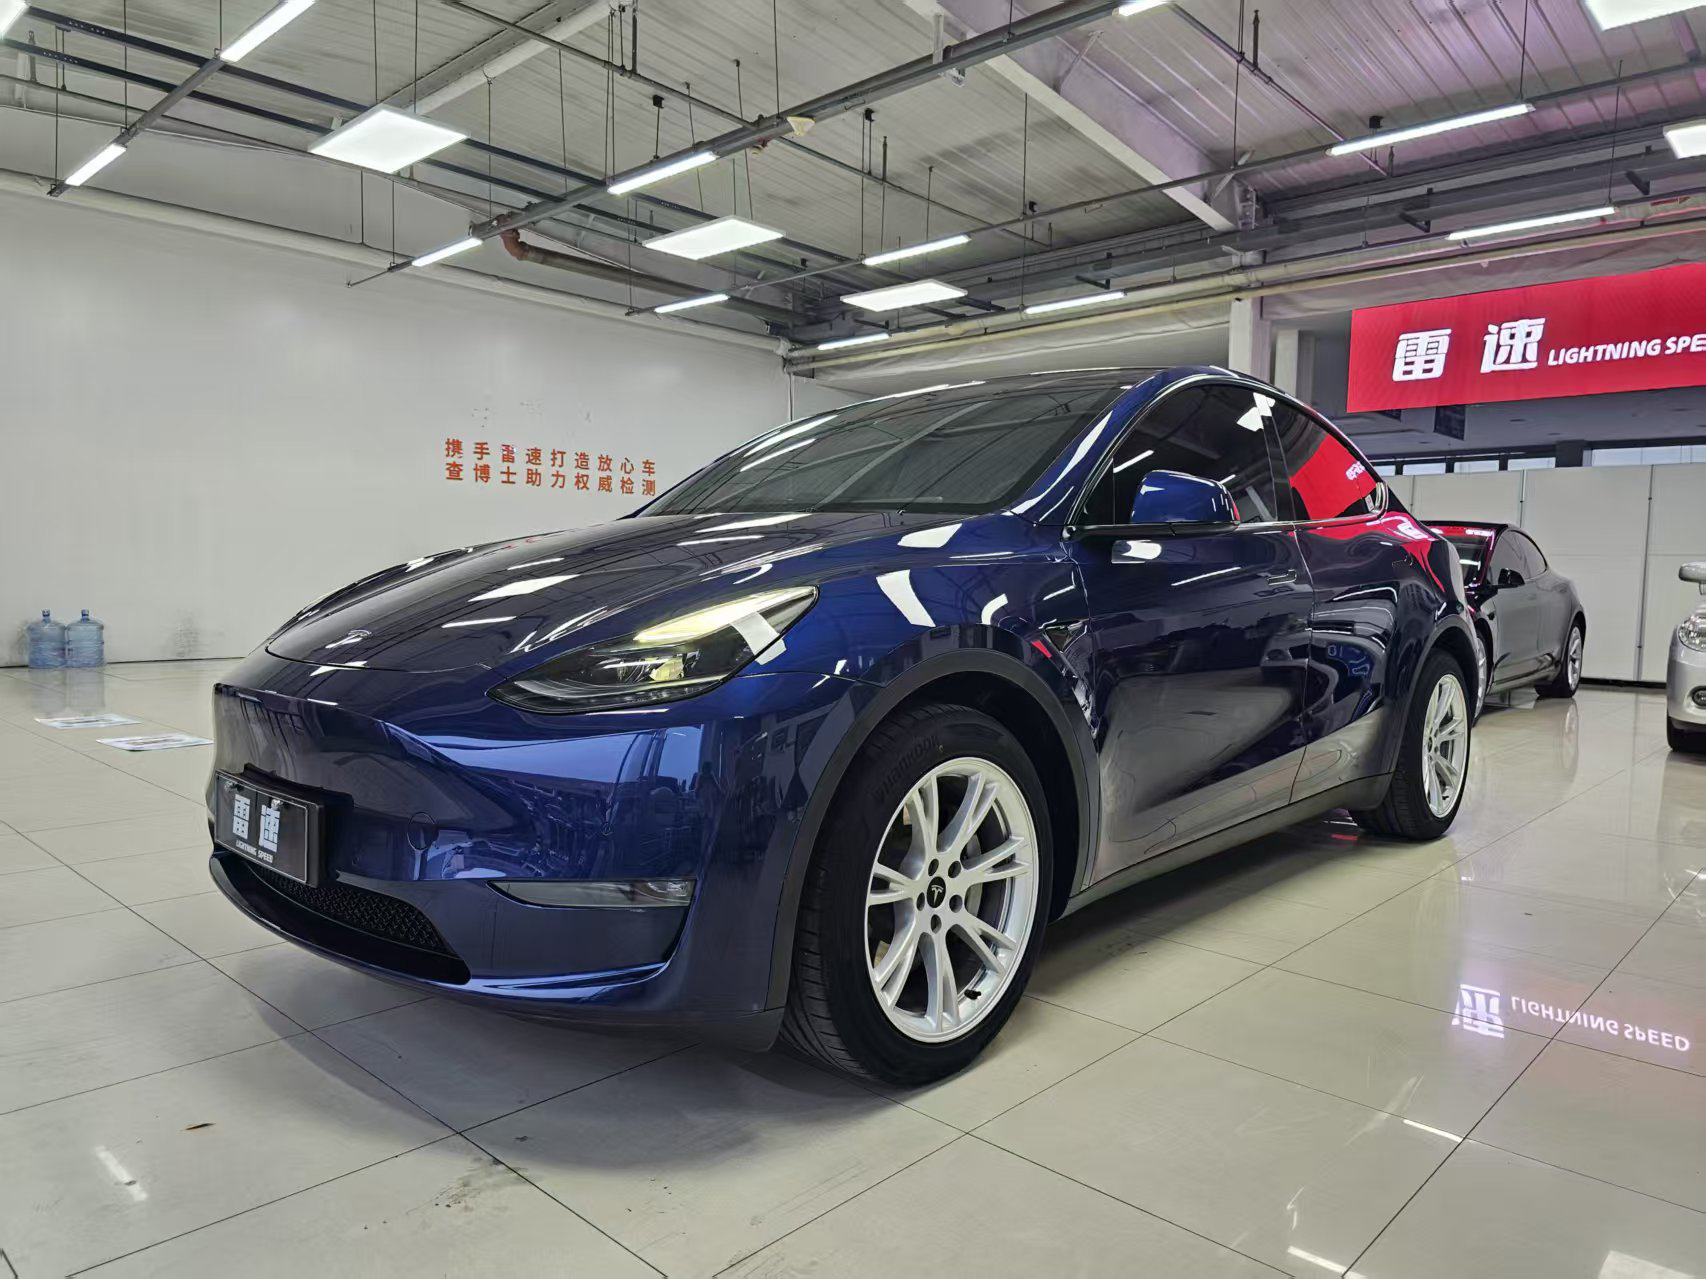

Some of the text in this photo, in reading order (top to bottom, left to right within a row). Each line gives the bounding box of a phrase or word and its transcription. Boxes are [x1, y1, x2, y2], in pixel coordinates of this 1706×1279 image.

[1392, 317, 1546, 382] 雷速
[1547, 338, 1662, 366] LIGHTNING
[445, 461, 656, 497] 查博士助力权威检测
